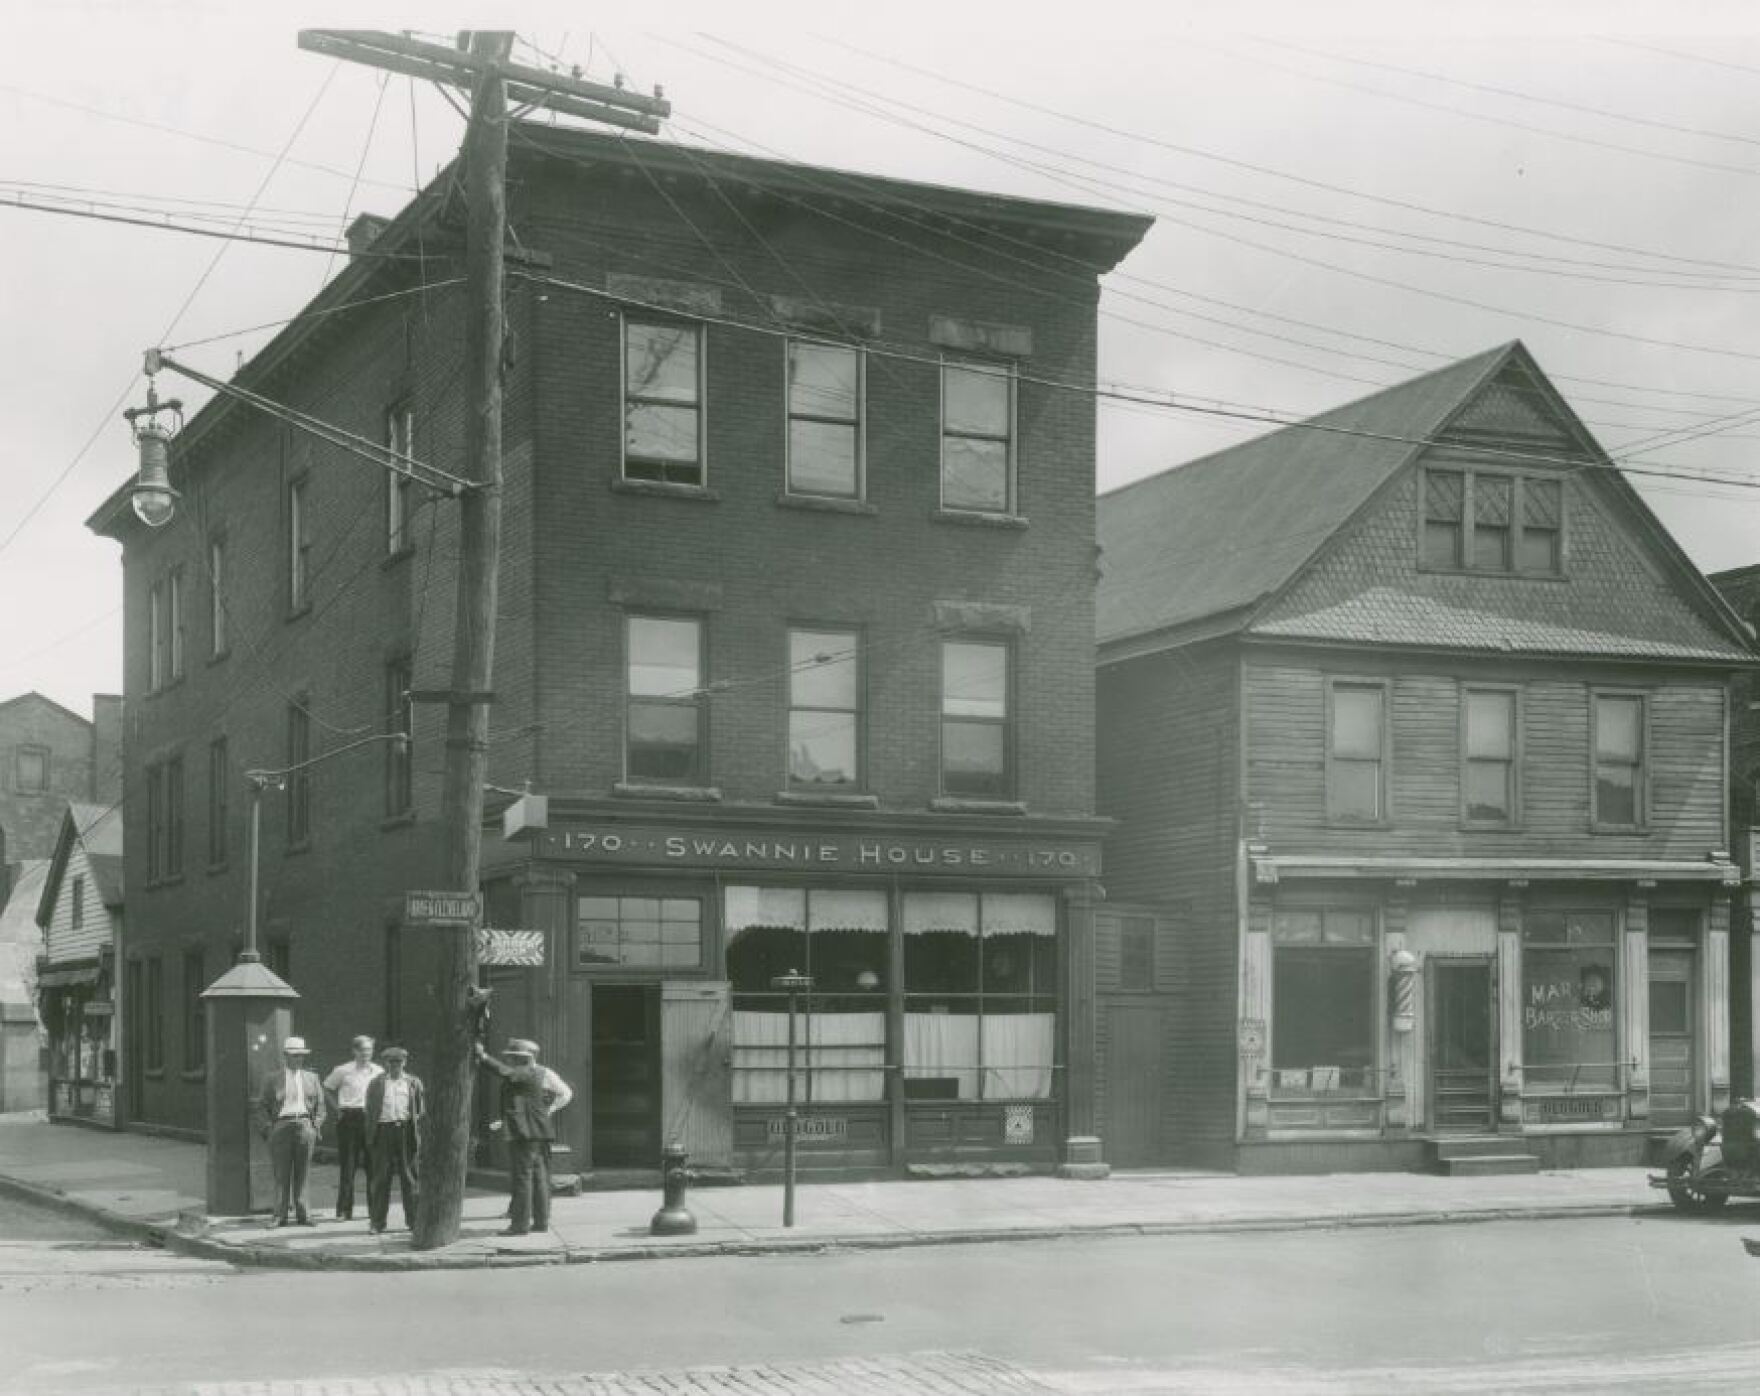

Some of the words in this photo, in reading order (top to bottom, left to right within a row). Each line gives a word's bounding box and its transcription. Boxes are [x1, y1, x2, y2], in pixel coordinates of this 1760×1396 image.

[565, 831, 621, 851] 170
[665, 836, 839, 862] SWANNIE
[860, 844, 990, 865] HOUSE
[1028, 851, 1078, 865] 170
